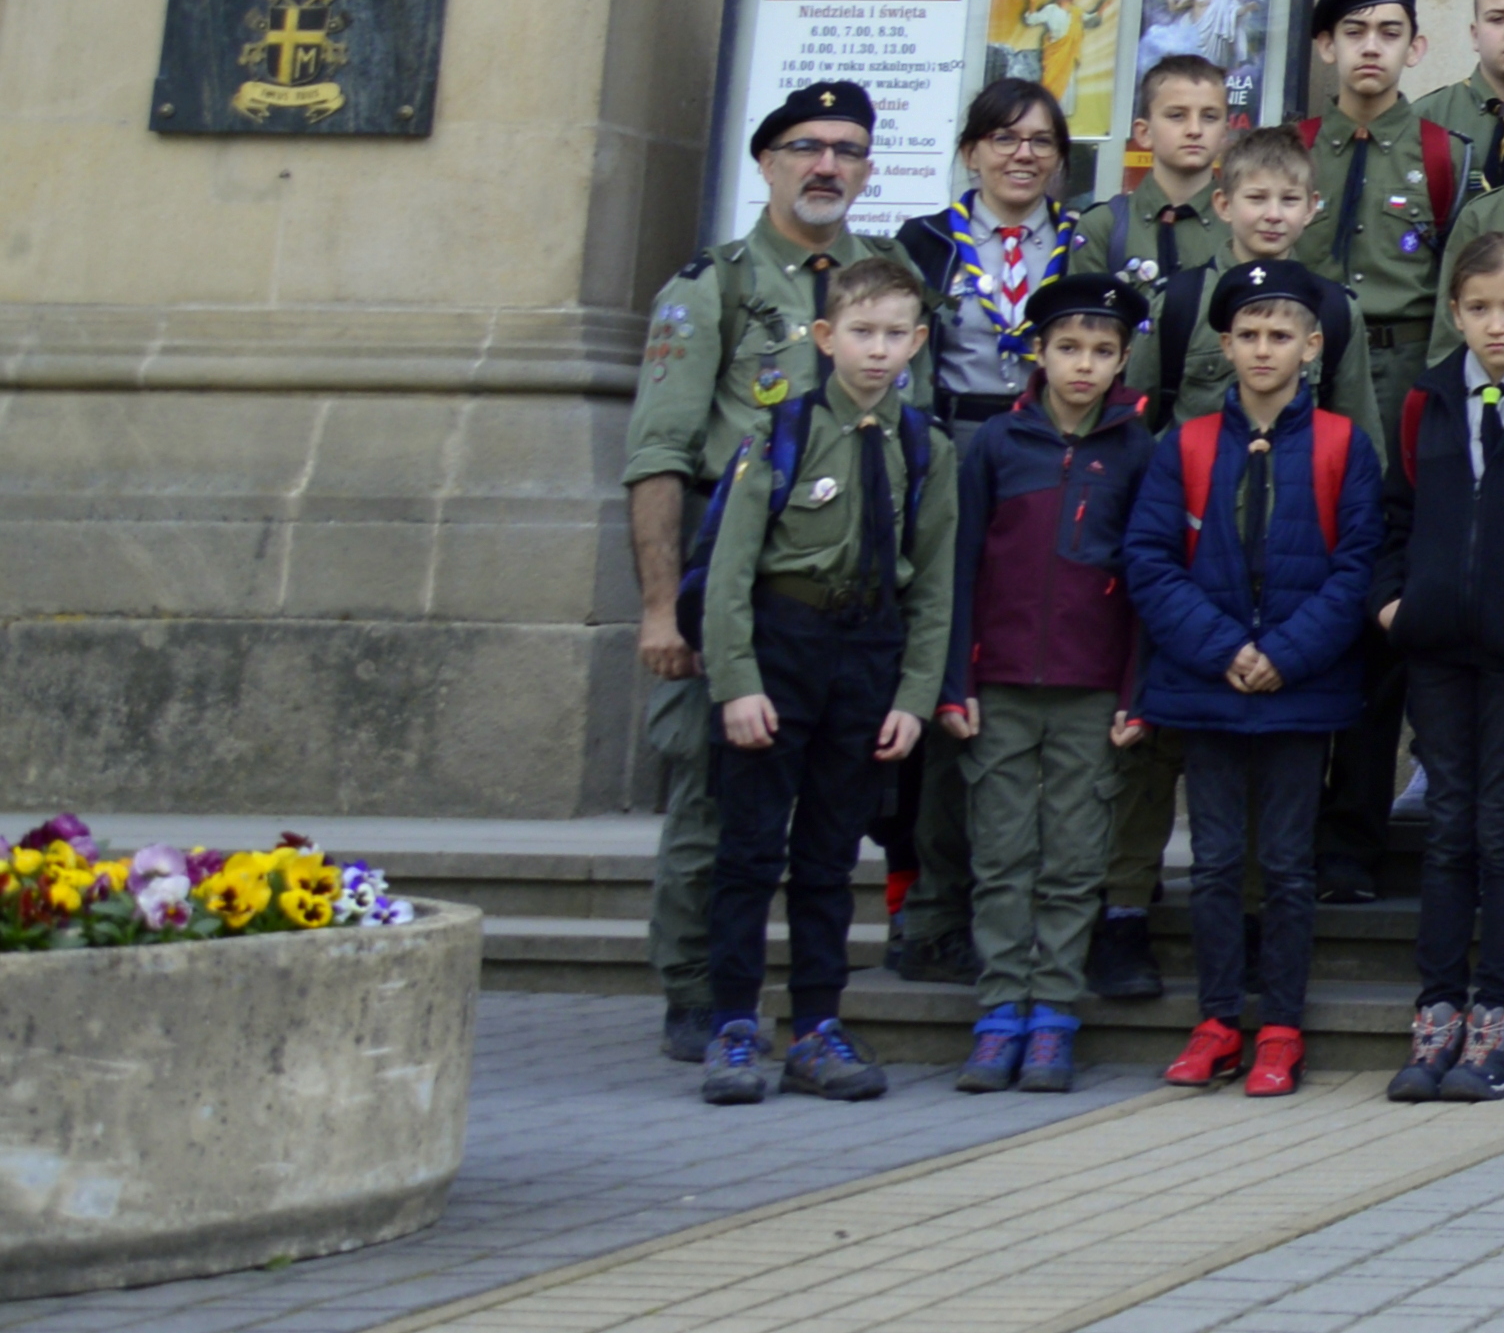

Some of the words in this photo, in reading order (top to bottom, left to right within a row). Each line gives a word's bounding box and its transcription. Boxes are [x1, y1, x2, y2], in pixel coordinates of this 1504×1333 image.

[799, 5, 865, 18] Niedziela
[869, 6, 875, 18] i
[879, 4, 927, 21] święta
[811, 26, 841, 38] 6.00,
[844, 26, 874, 38] 7.00,
[800, 43, 837, 55] 10.00,
[841, 43, 878, 55] 11.30,
[882, 43, 917, 54] 13.00
[782, 60, 815, 71] 16.00
[819, 61, 835, 72] (w
[837, 61, 865, 71] roku
[876, 78, 931, 91] wakacje)
[885, 166, 936, 177] Adoracja
